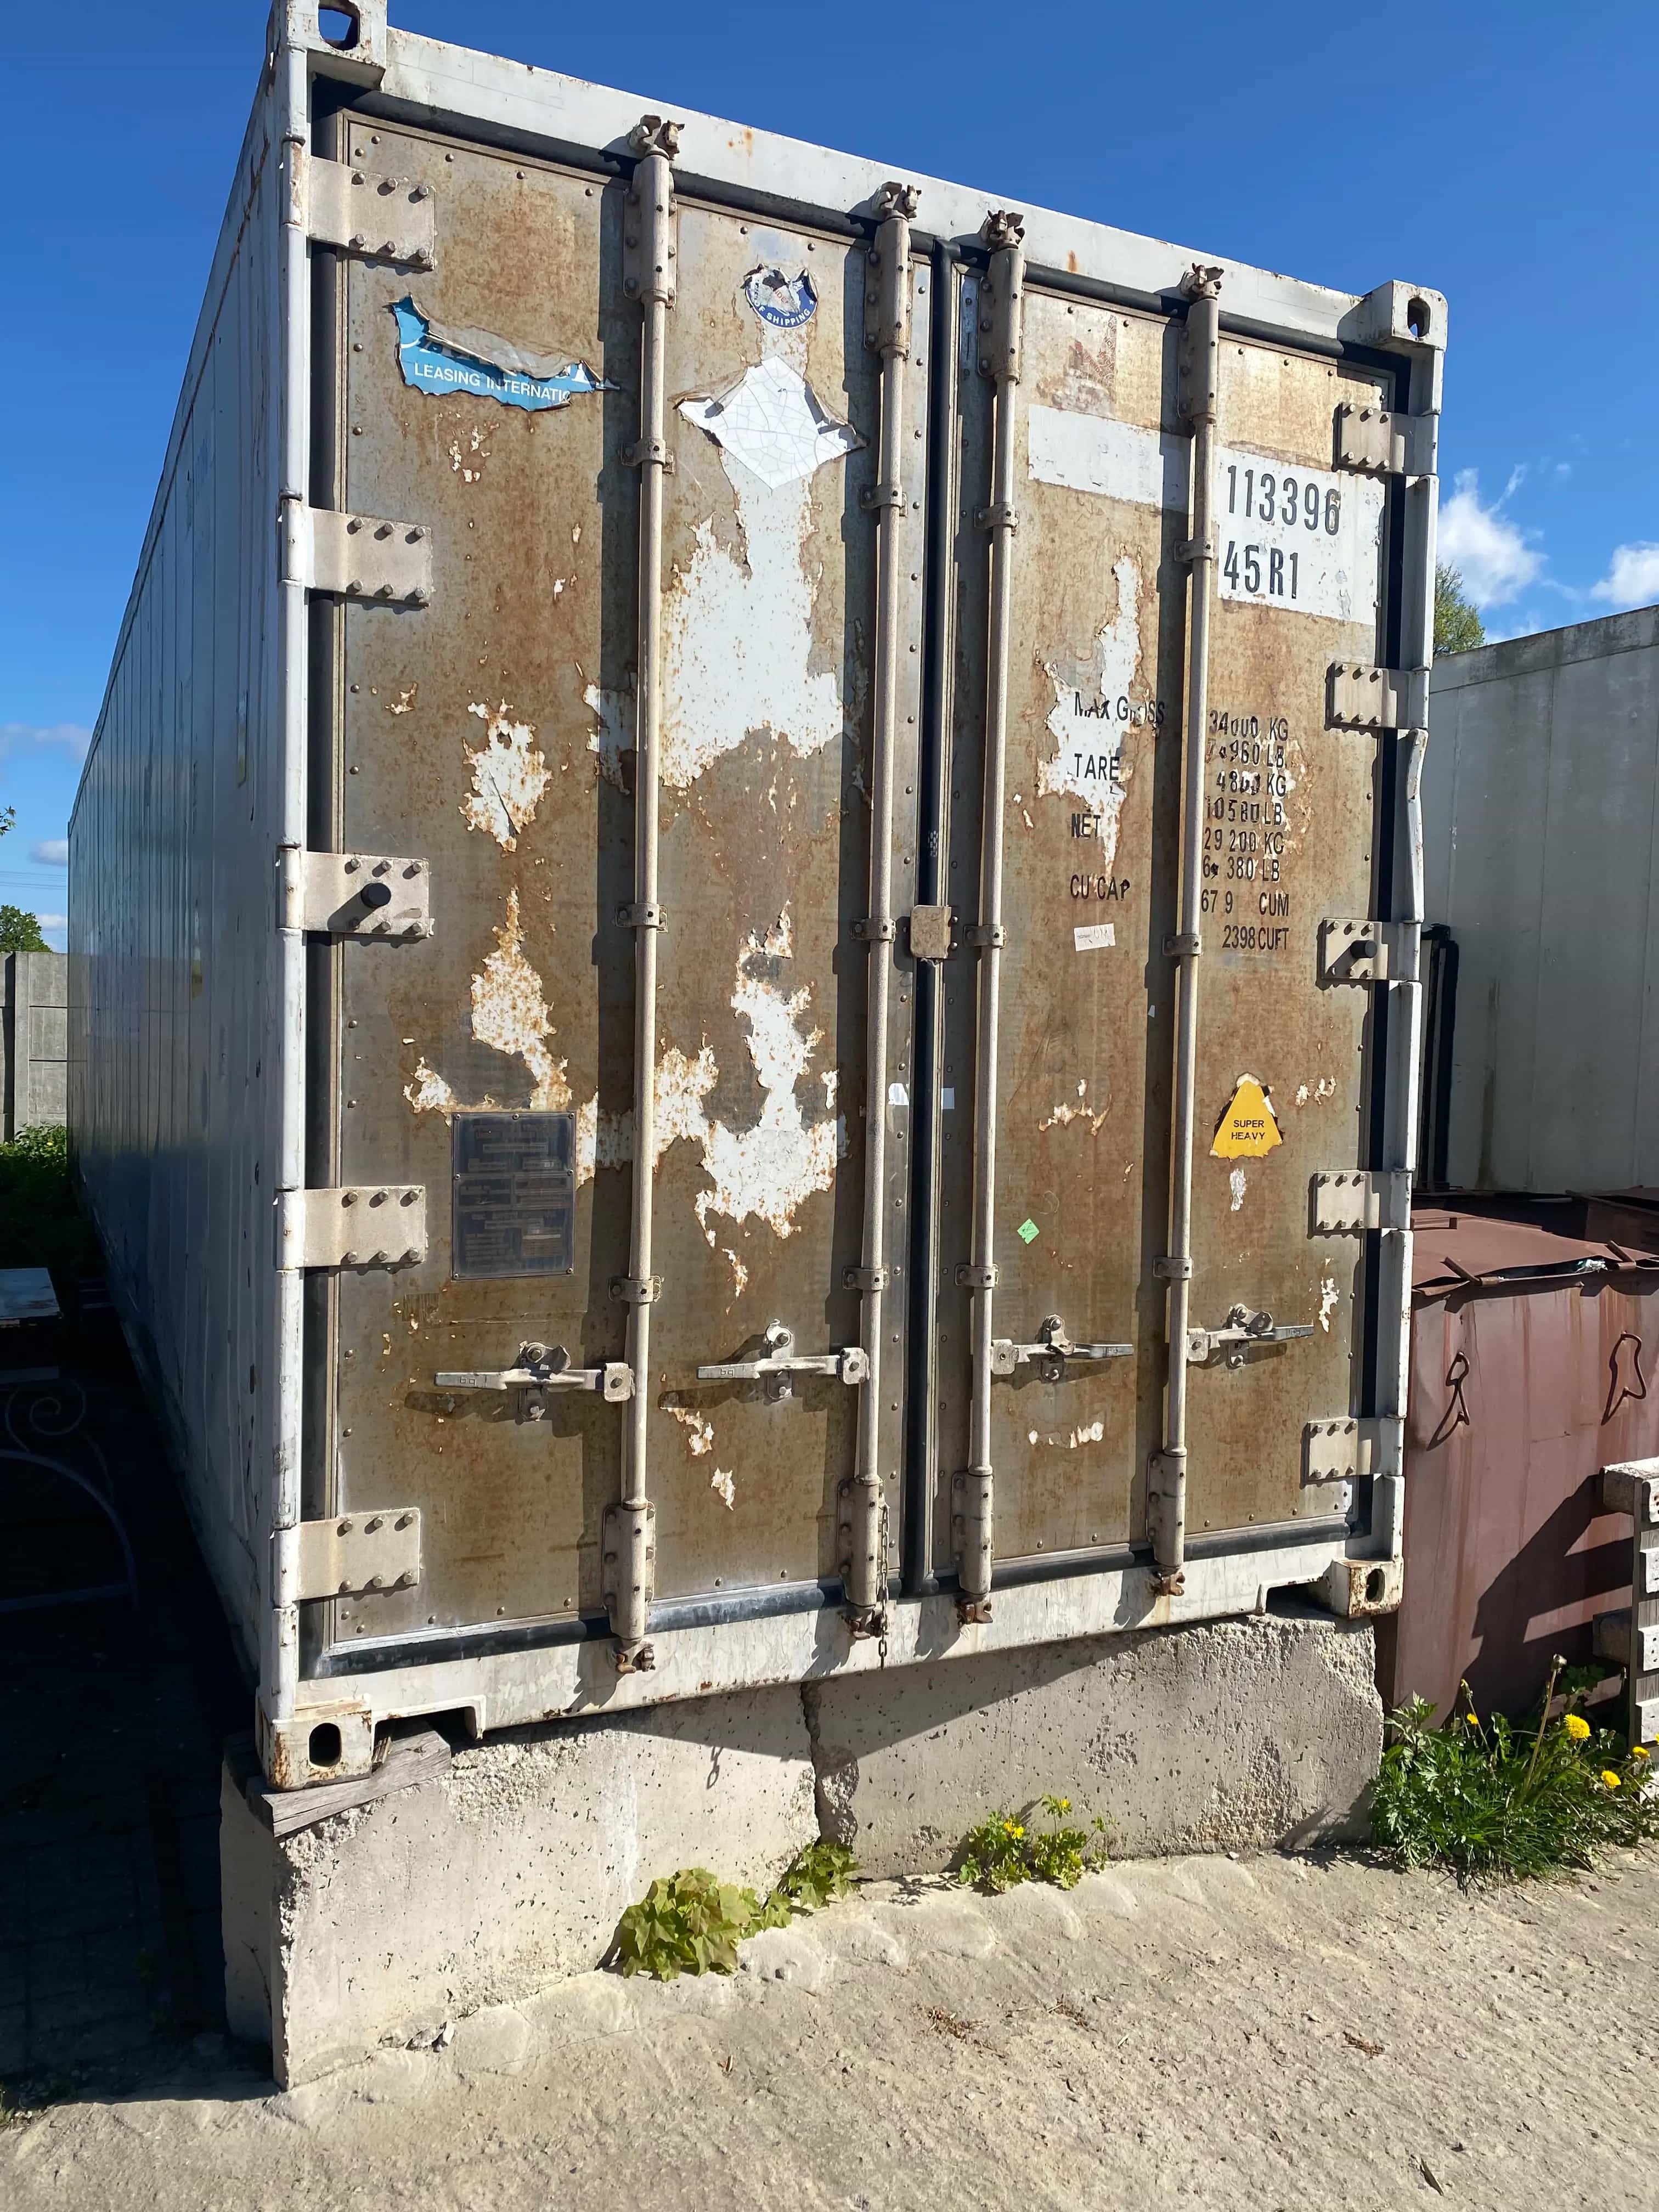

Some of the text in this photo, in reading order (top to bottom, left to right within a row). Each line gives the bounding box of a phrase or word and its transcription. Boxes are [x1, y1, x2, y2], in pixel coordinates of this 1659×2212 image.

[754, 301, 810, 326] OF SHIPPING
[414, 362, 481, 387] LEASING
[1228, 465, 1342, 536] 113396
[1223, 540, 1299, 599] 45R1
[1269, 716, 1288, 741] KG
[1074, 753, 1120, 781] TARE
[1267, 743, 1284, 768] LB
[1267, 772, 1286, 797] KG
[1071, 813, 1101, 838] NET
[1264, 802, 1282, 826] LB
[1264, 831, 1284, 855] KG
[1262, 859, 1280, 882] LB
[1070, 874, 1090, 900] CU
[1259, 892, 1289, 917] CUM
[1222, 924, 1256, 950] 2398
[1231, 1132, 1265, 1140] HEAVY
[1233, 1120, 1265, 1128] SUPER
